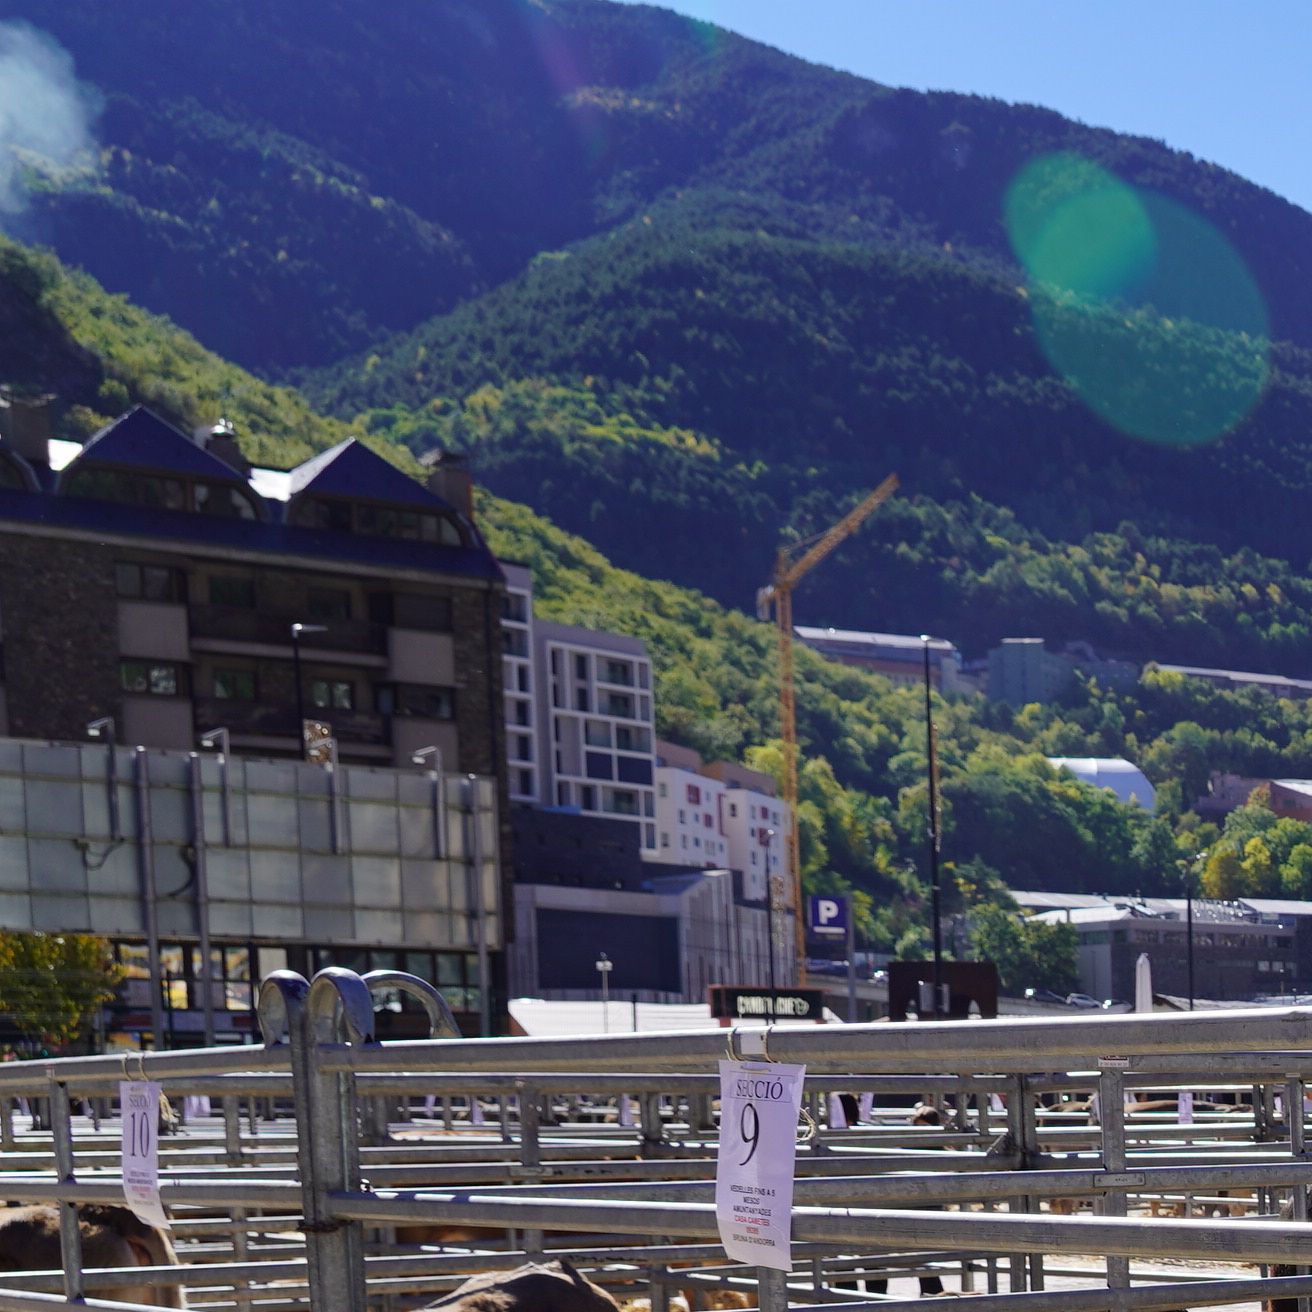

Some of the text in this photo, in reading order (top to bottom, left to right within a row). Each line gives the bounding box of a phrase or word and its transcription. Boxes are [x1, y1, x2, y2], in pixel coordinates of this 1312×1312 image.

[818, 899, 839, 925] P
[735, 1077, 784, 1101] SECCIÓ
[130, 1111, 150, 1159] 10
[738, 1102, 760, 1167] 9
